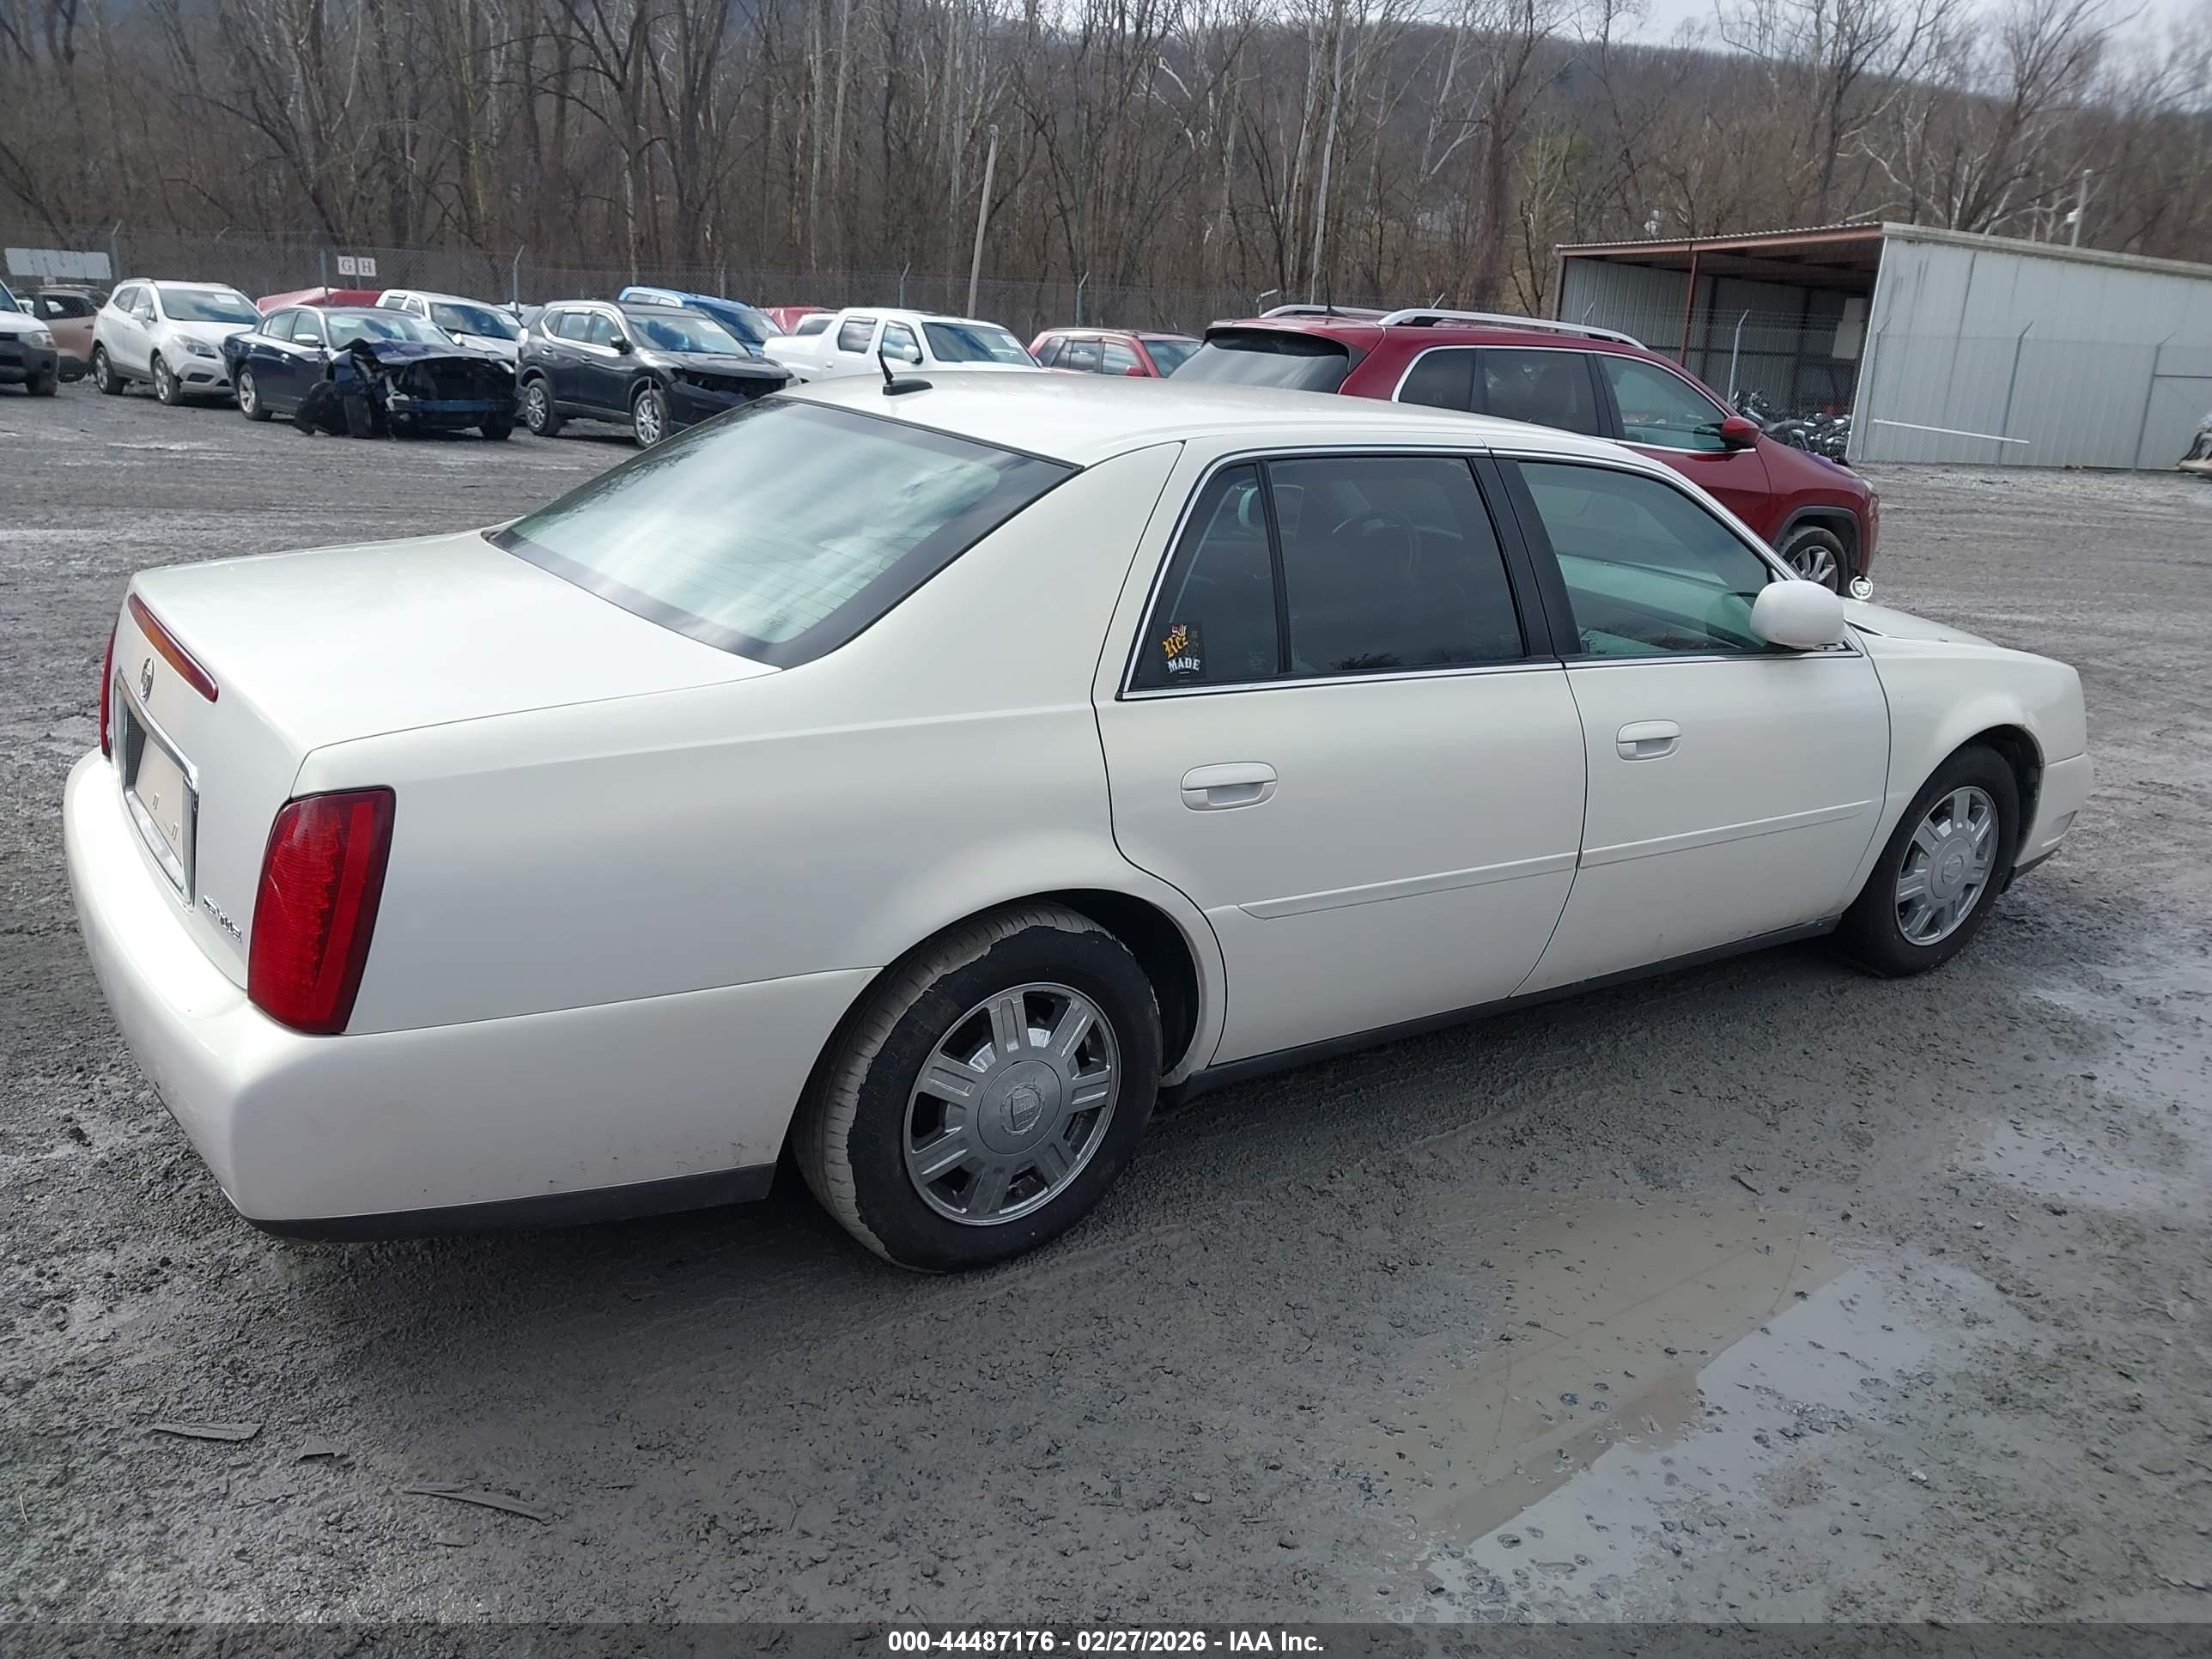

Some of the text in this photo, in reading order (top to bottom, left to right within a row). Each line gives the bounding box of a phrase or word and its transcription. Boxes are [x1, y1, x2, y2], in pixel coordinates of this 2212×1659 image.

[341, 259, 352, 272] G
[362, 260, 373, 273] H
[1167, 657, 1200, 673] MADE
